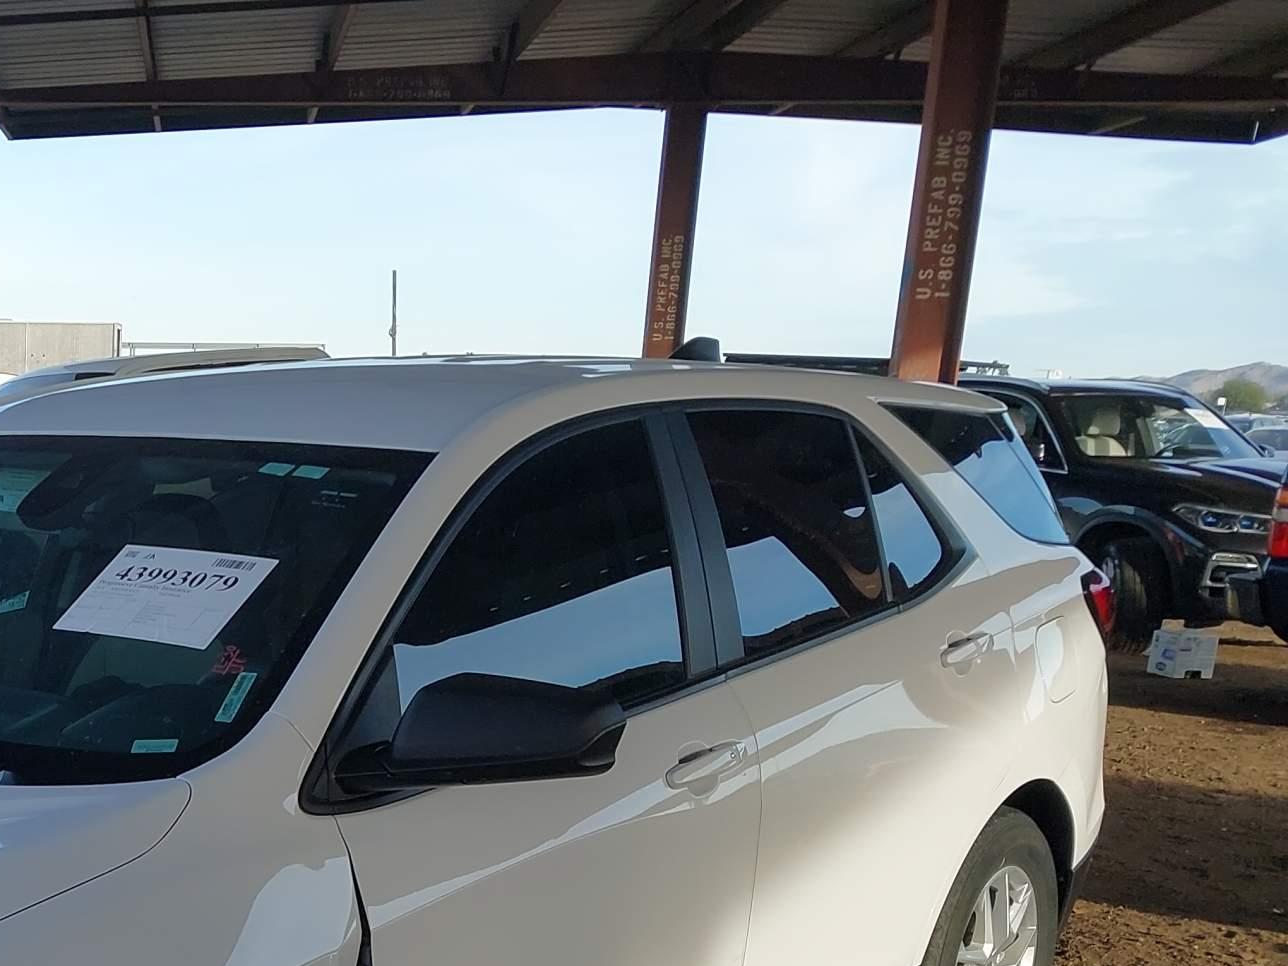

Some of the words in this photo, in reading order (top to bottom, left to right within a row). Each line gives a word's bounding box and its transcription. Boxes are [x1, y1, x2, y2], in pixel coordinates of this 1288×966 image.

[922, 174, 948, 252] PREFAB
[935, 128, 955, 167] INC.
[934, 129, 973, 298] 1-866-799-0969
[656, 263, 670, 312] PREFAB
[665, 235, 684, 341] 1-866-799-0969
[115, 565, 240, 592] 43993079
